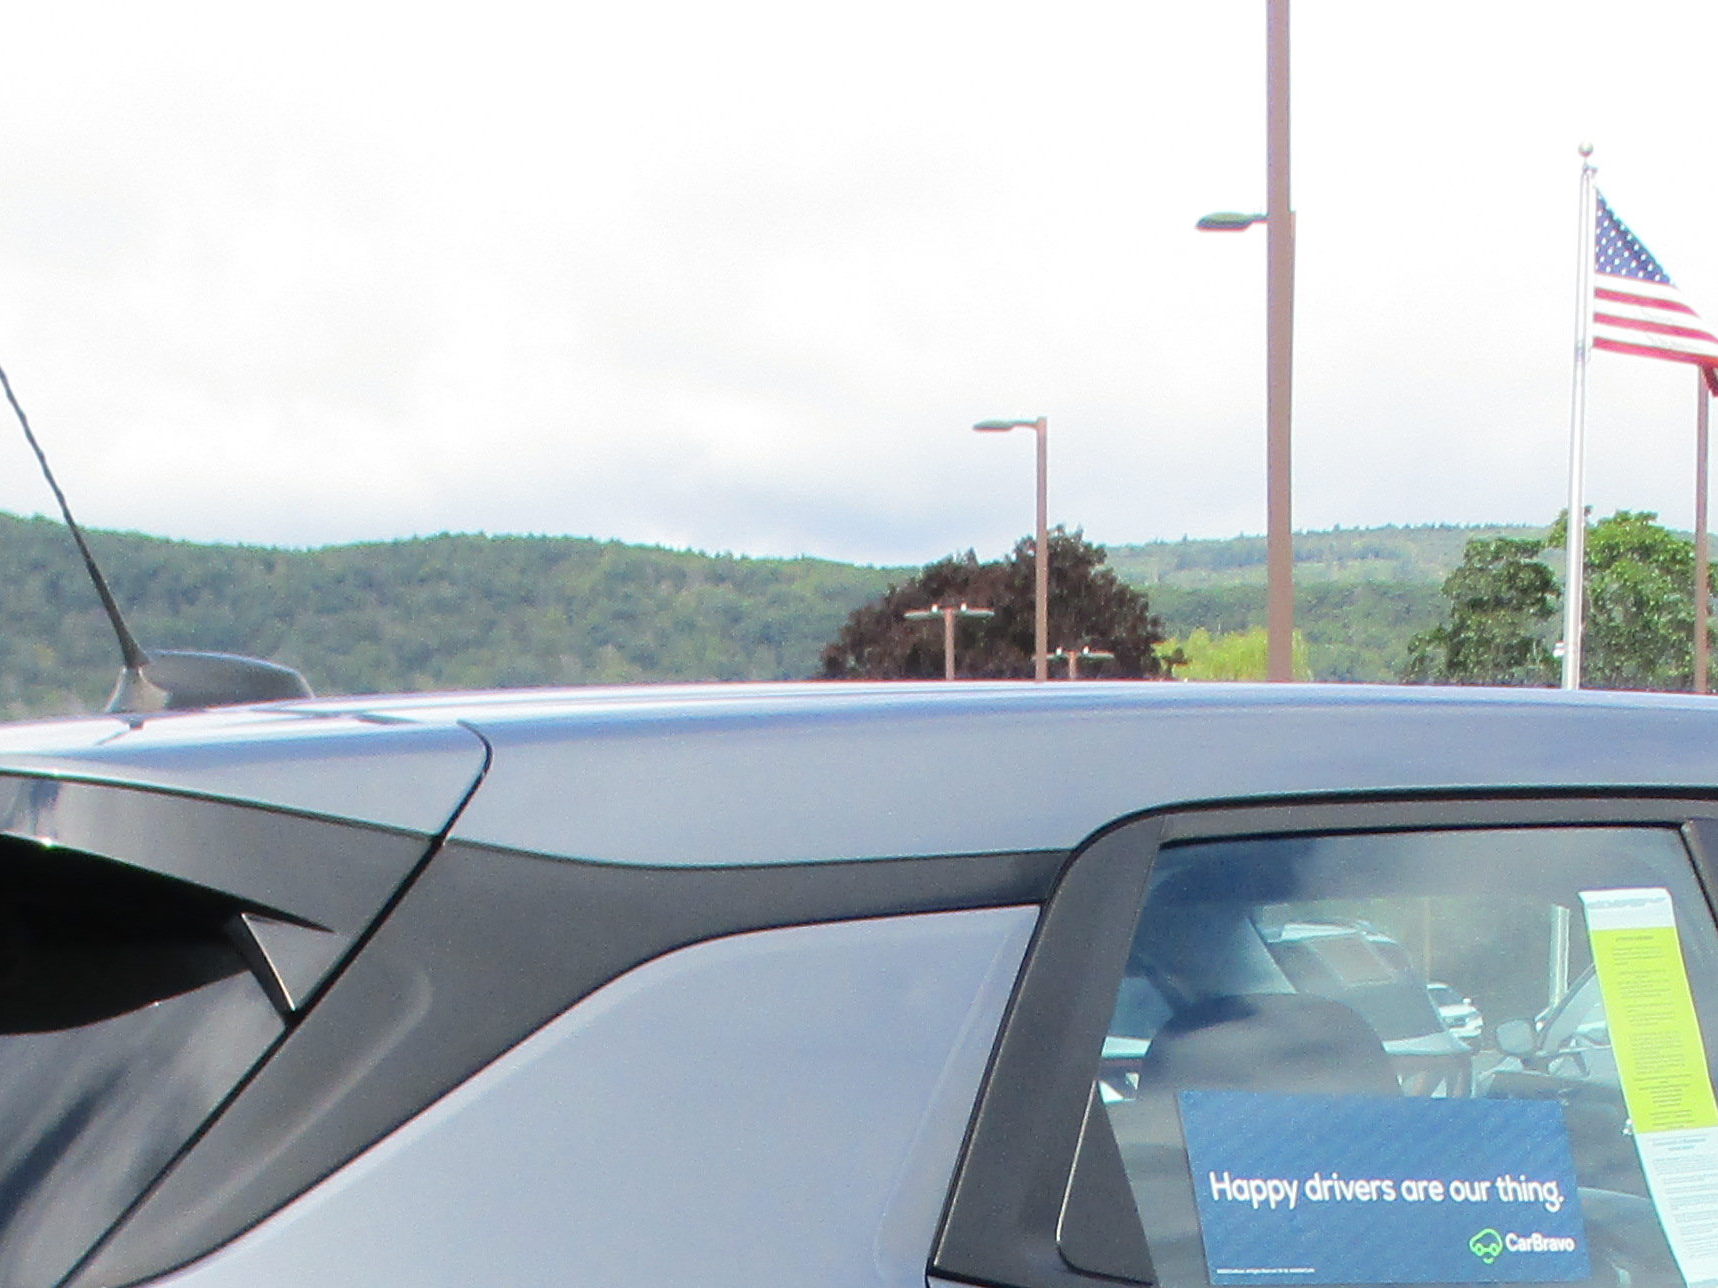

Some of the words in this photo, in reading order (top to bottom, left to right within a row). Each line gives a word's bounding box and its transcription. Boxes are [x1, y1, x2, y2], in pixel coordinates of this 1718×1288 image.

[1209, 1171, 1298, 1209] Happy
[1304, 1172, 1396, 1202] drivers
[1400, 1178, 1445, 1202] are
[1449, 1178, 1490, 1202] our
[1496, 1175, 1565, 1212] thing.
[1505, 1233, 1575, 1252] CarBravo
